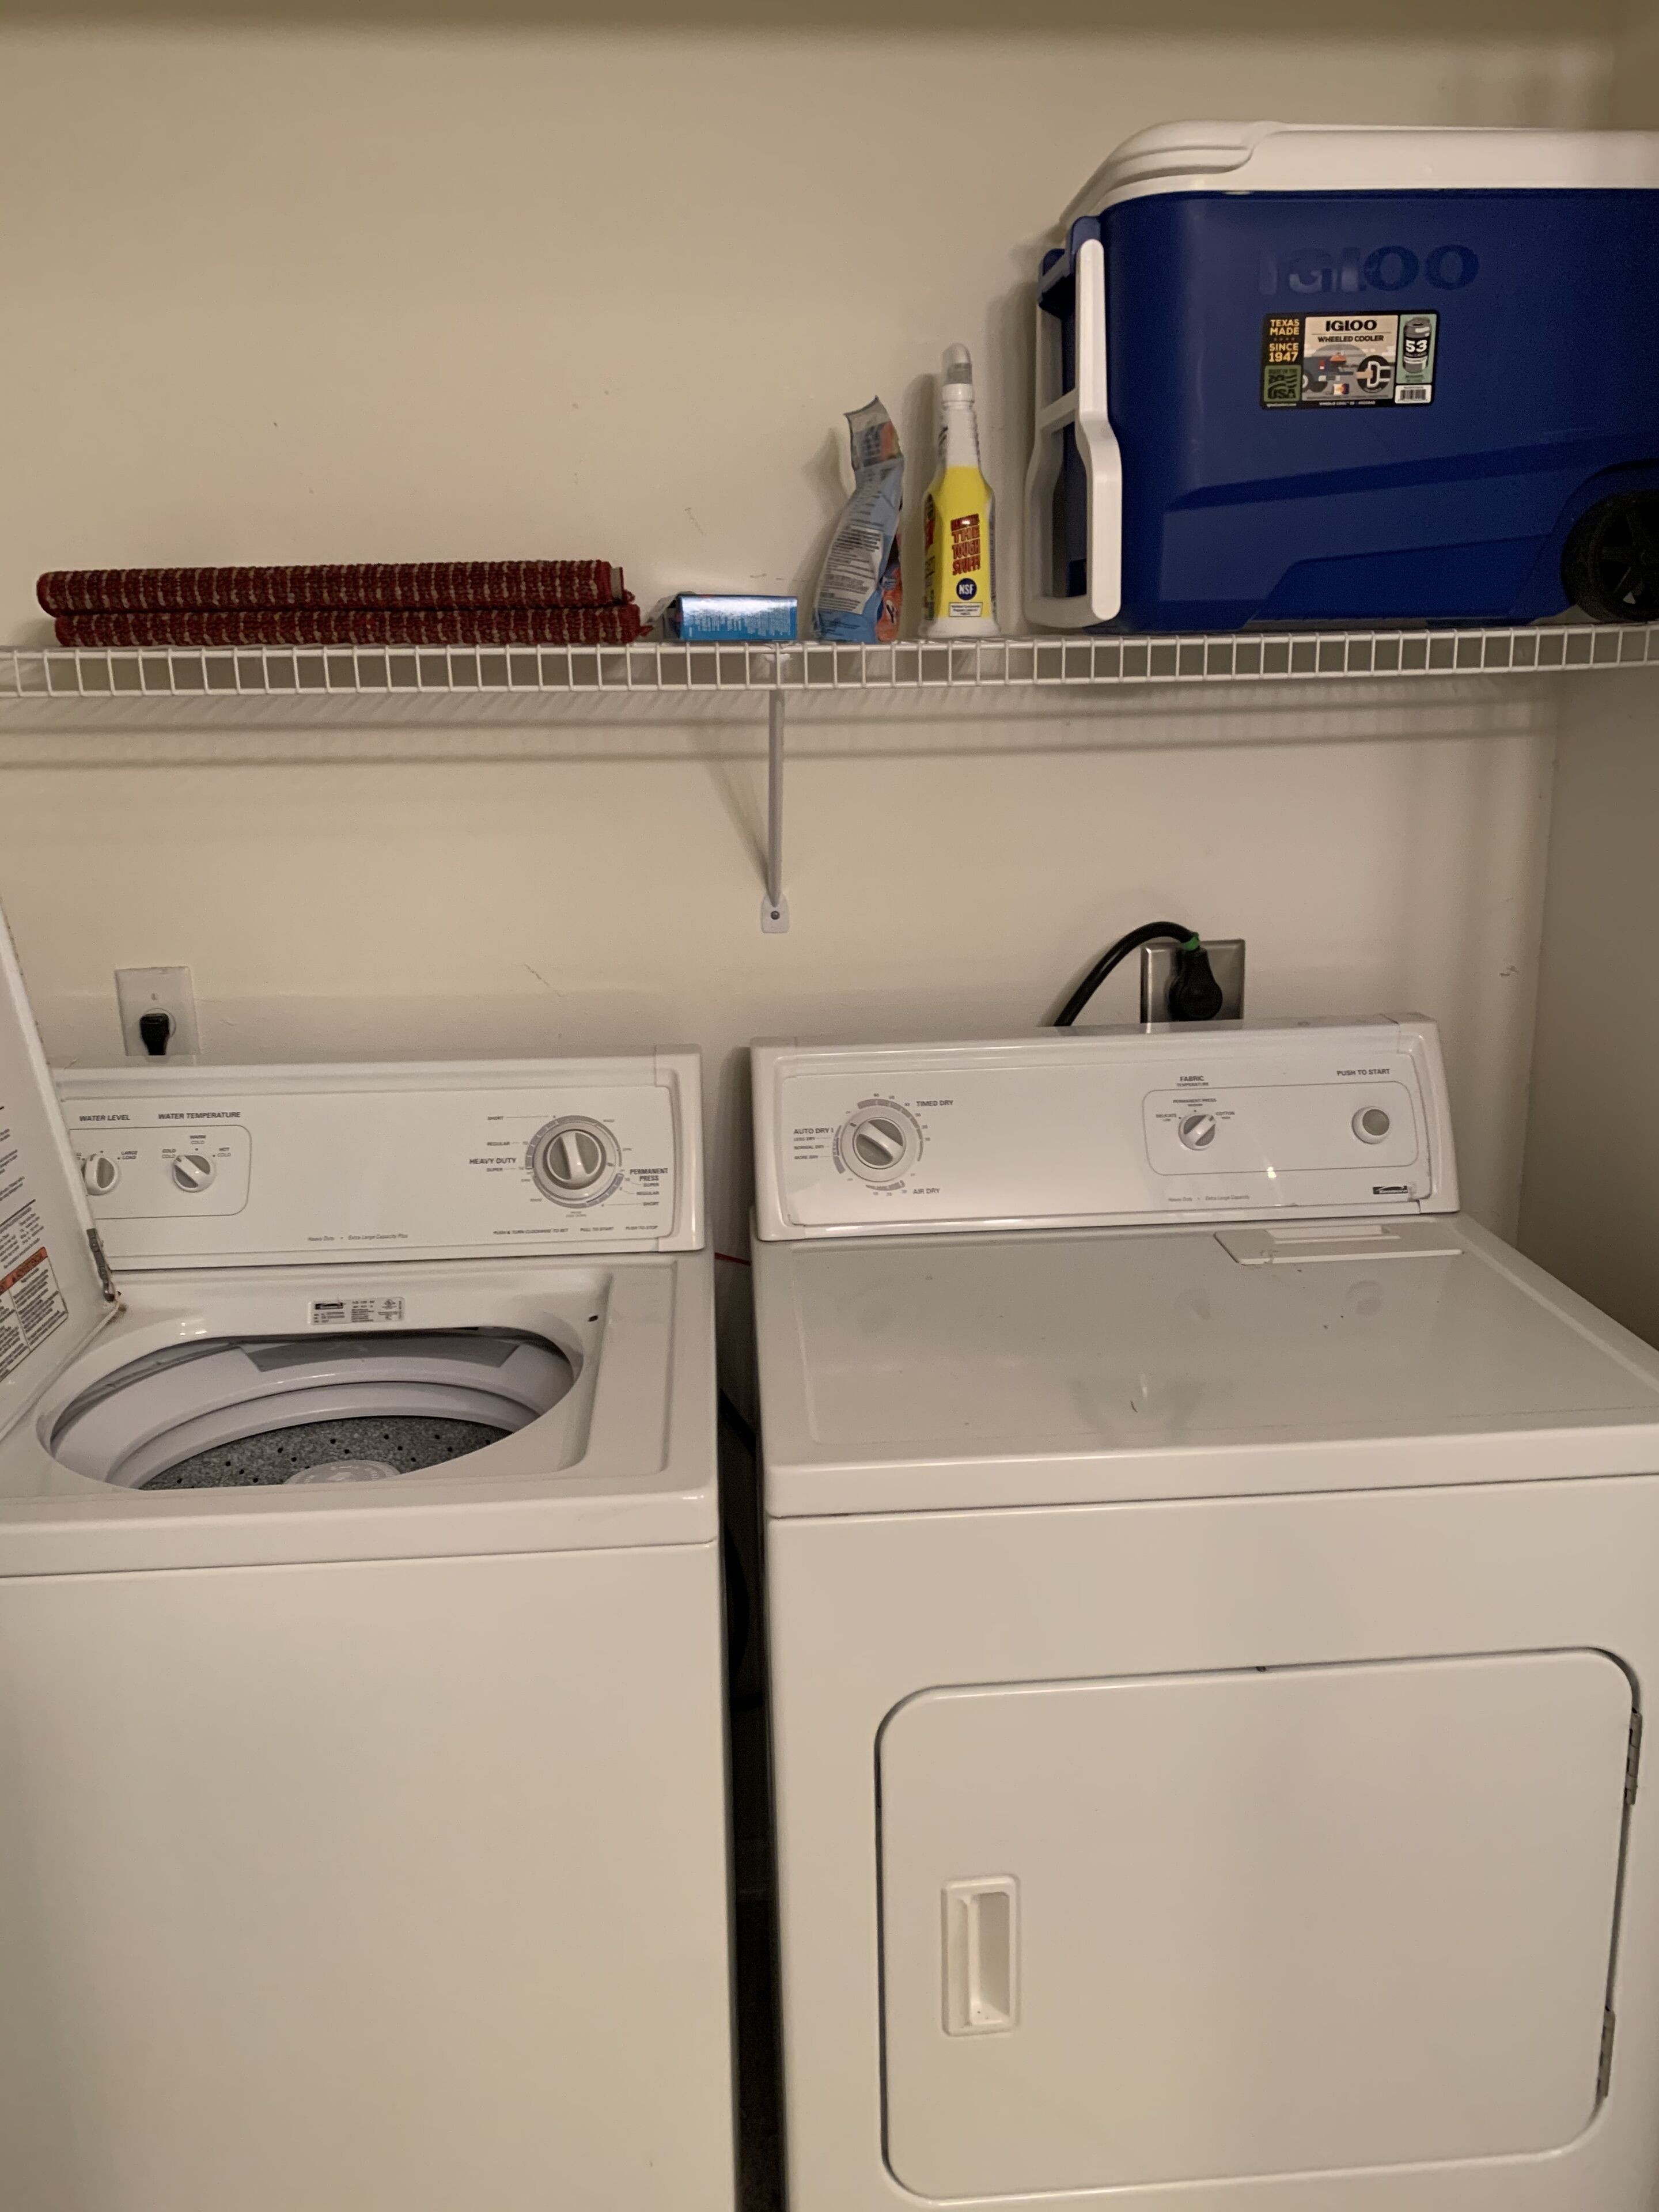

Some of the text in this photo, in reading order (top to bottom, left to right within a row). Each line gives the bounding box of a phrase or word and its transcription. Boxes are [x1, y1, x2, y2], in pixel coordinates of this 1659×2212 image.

[1270, 319, 1300, 327] TEXAS
[1326, 320, 1377, 332] IGLOO
[1270, 327, 1300, 335] MADE
[1269, 343, 1299, 351] SINCE
[1406, 339, 1427, 353] 53
[1269, 352, 1298, 362] 1947
[952, 525, 980, 543] THE
[952, 539, 980, 560] TOUGH
[959, 584, 974, 594] NSF
